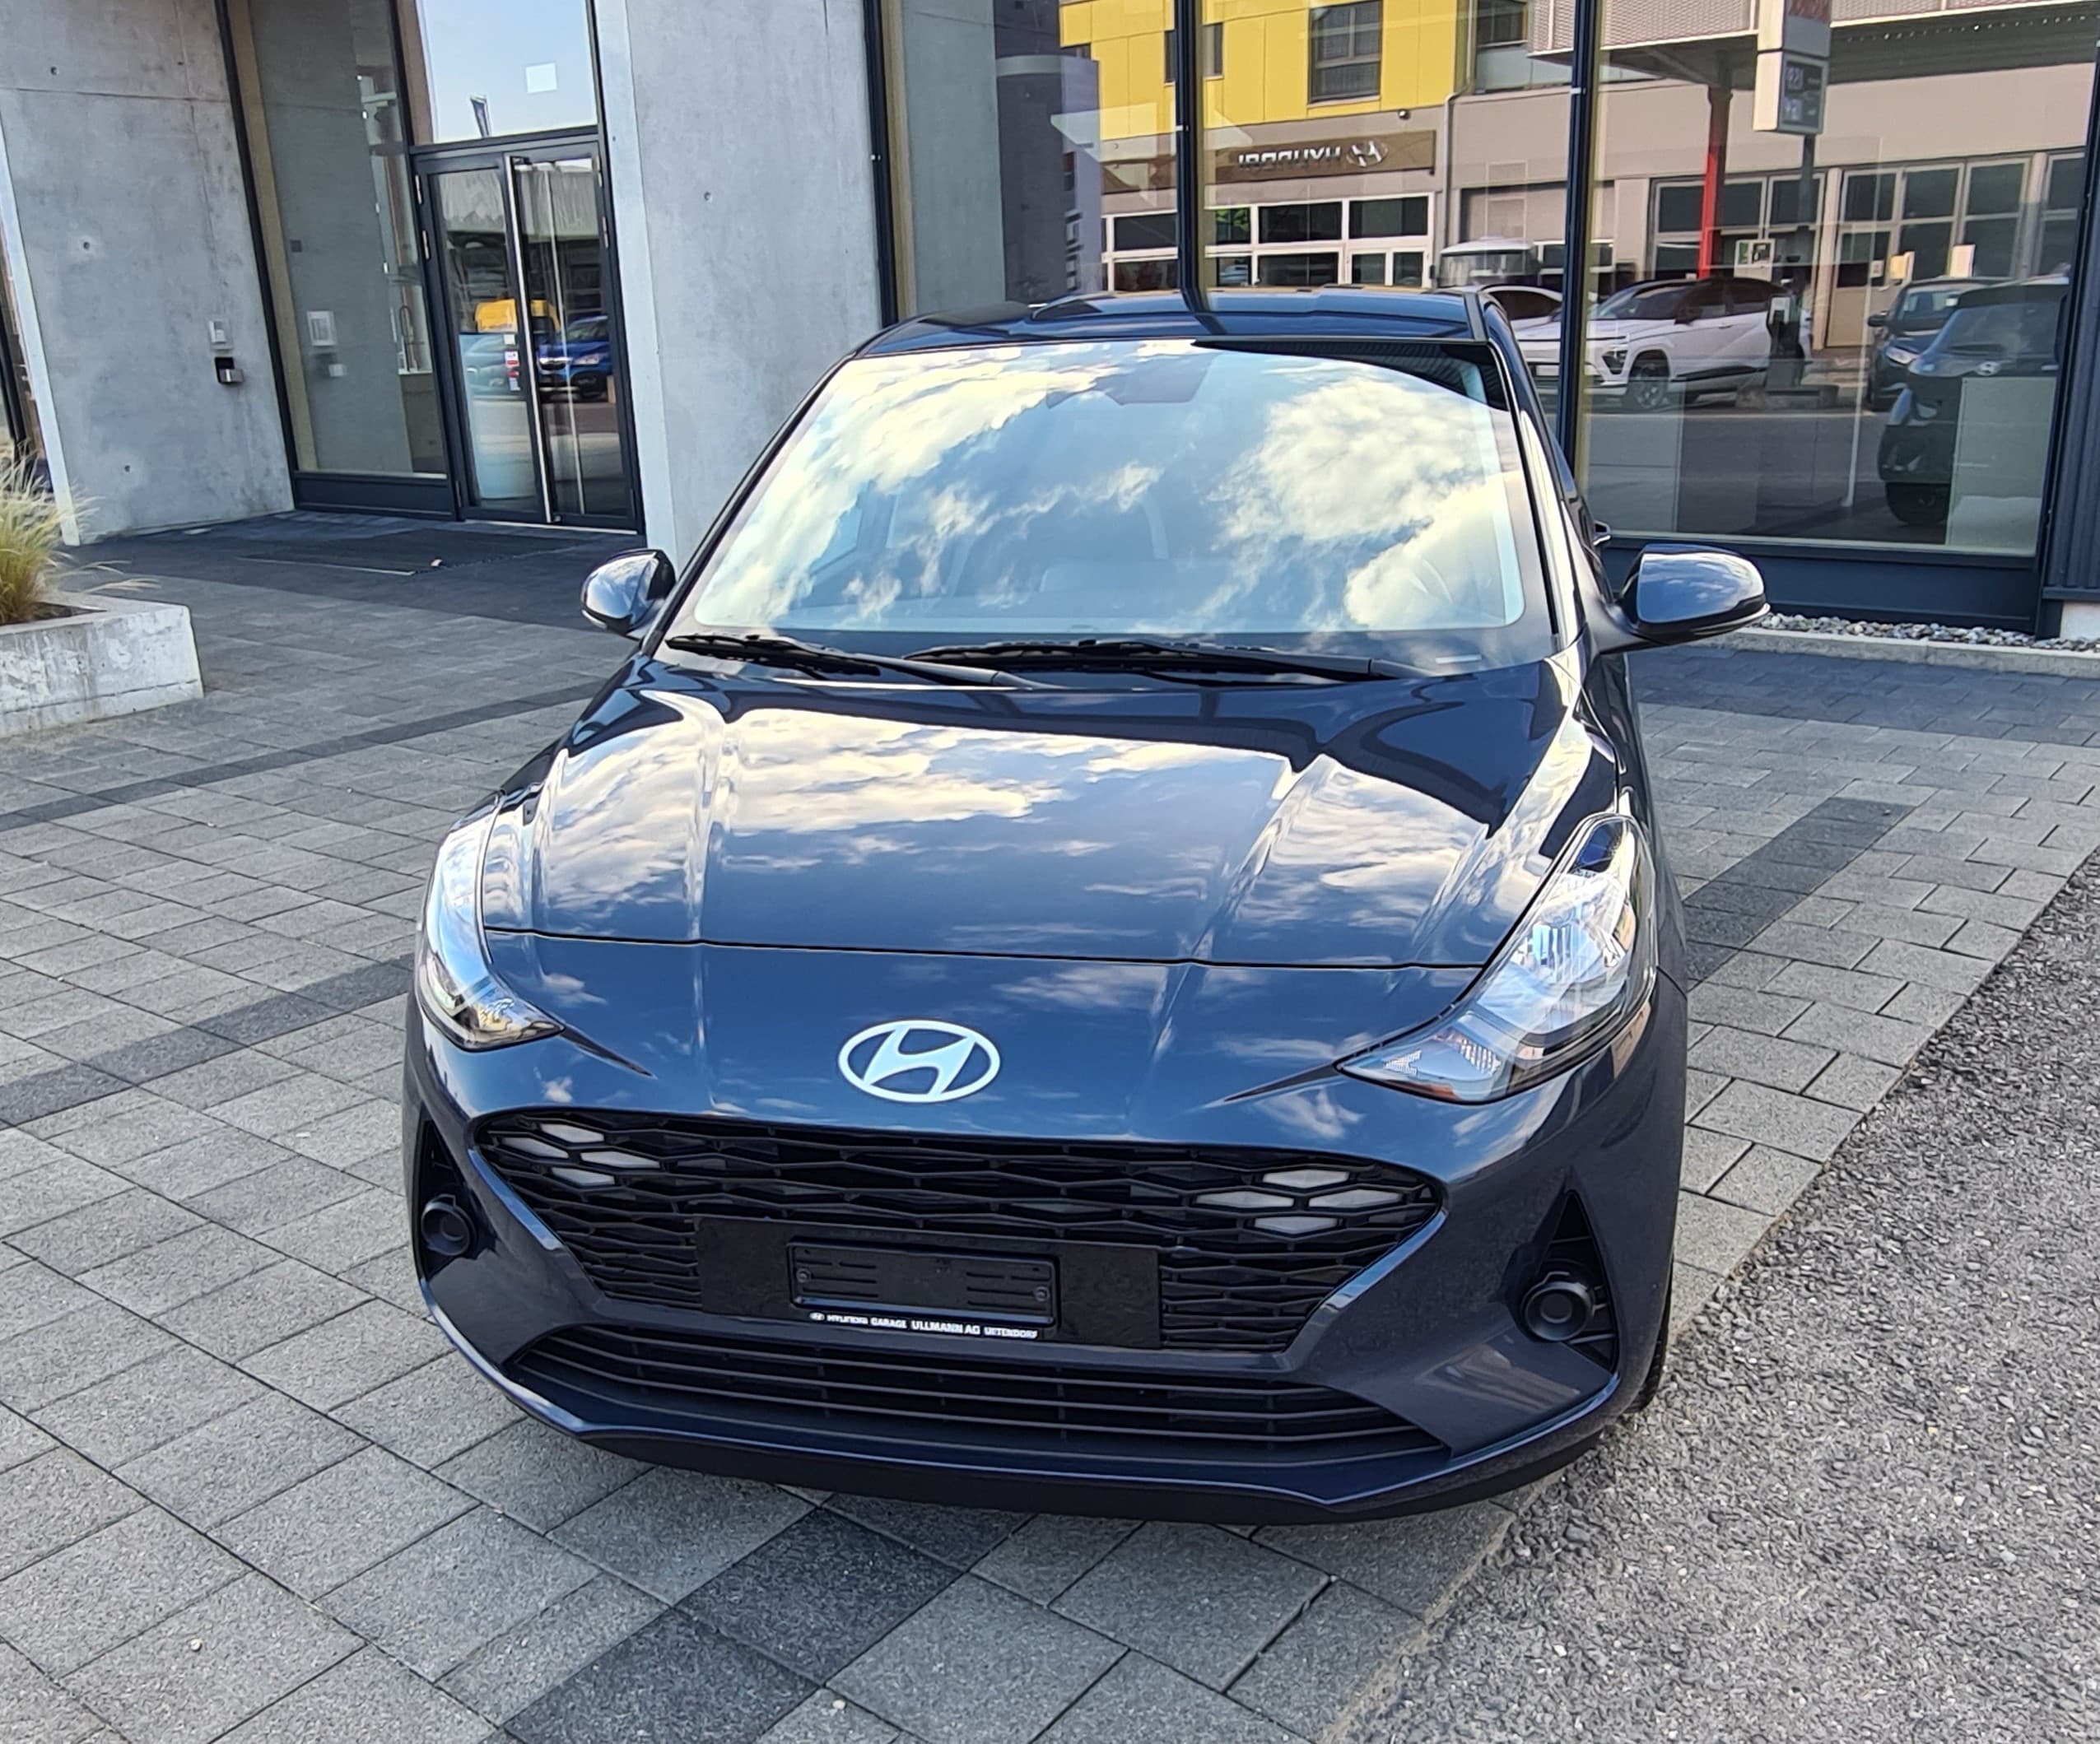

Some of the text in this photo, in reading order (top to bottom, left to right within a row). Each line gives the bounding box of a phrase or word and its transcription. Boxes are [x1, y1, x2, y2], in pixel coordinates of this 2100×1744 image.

[826, 1314, 868, 1324] HYUNDAI
[871, 1318, 907, 1328] GARAGE
[911, 1320, 963, 1332] ULLMANN
[965, 1325, 980, 1335] AG
